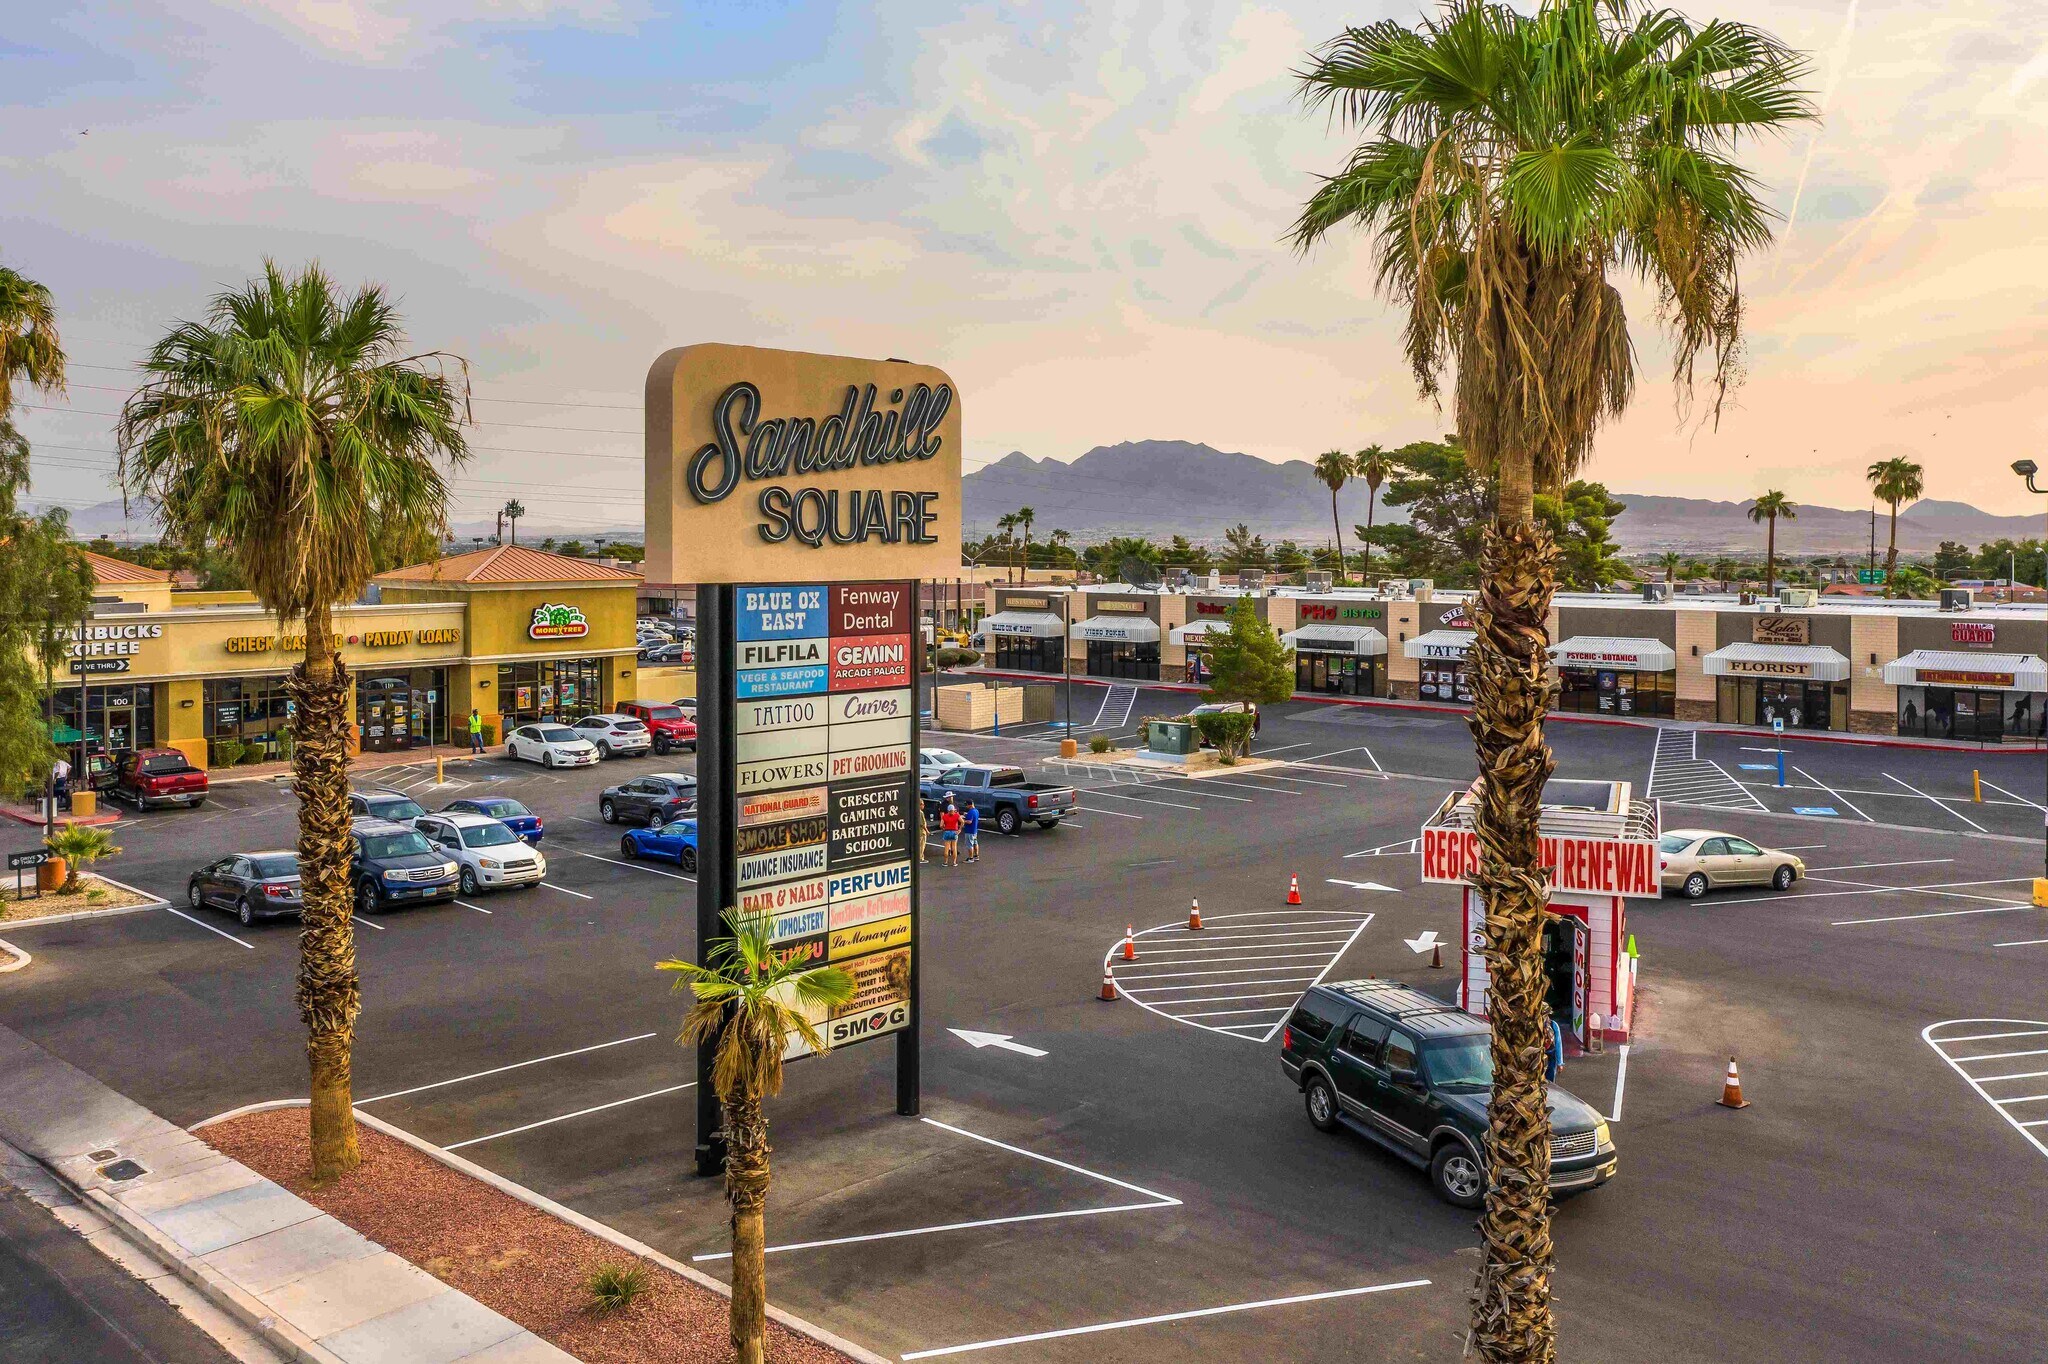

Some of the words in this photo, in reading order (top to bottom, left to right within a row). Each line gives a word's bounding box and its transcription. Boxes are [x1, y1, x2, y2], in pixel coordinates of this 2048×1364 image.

[687, 381, 952, 504] Sandhill
[757, 486, 939, 548] SQUARE
[746, 592, 792, 611] BLUE
[798, 591, 820, 609] OX
[840, 588, 899, 609] Fenway
[761, 612, 806, 631] EAST
[843, 611, 893, 630] Dental
[1443, 607, 1463, 622] STE
[227, 636, 275, 652] CHECK
[282, 633, 344, 650] CASG
[364, 629, 413, 647] PAYDAY
[419, 627, 461, 644] LOANS
[1952, 629, 1993, 642] GUARD
[745, 643, 820, 664] FILFILA
[836, 644, 904, 666] GEMINI
[1566, 652, 1597, 660] PSYCHIC
[1602, 654, 1638, 662] BOTANICA
[740, 673, 767, 683] VEGE
[770, 672, 777, 681] &
[780, 669, 824, 680] SEAFOOD
[835, 669, 872, 678] ARCADE
[874, 666, 905, 676] PALACE
[1731, 662, 1808, 674] FLORIST
[751, 680, 814, 693] RESTAURANT
[1456, 685, 1469, 693] PAR
[113, 698, 128, 706] 100
[843, 696, 898, 719] Curves
[754, 702, 814, 727] TATTOO
[741, 762, 824, 785] FLOWERS
[832, 758, 852, 776] PET
[854, 750, 907, 773] GROOMING
[744, 801, 782, 817] NATIONAL
[783, 797, 809, 811] GUARD
[839, 789, 899, 809] CRESCENT
[840, 806, 886, 824] GAMING
[889, 805, 898, 816] &
[738, 825, 787, 852] SMOKE
[790, 819, 826, 844] SHOP
[832, 819, 905, 841] BARTENDING
[845, 837, 892, 854] SCHOOL
[741, 857, 778, 881] ADVANCE
[779, 849, 824, 874] INSURANCE
[1563, 839, 1658, 893] RENEWAL
[829, 866, 910, 898] PERFUME
[743, 892, 774, 913] HAIR
[776, 888, 786, 907] &
[789, 882, 824, 905] NAILS
[778, 911, 825, 937] UPHOLSTERY
[832, 935, 846, 949] La
[848, 925, 909, 945] Monarquia
[1574, 928, 1584, 1009] SMOG
[857, 977, 876, 989] SWEET
[843, 998, 876, 1012] EXECUTIVE
[877, 992, 899, 1003] EVENTS
